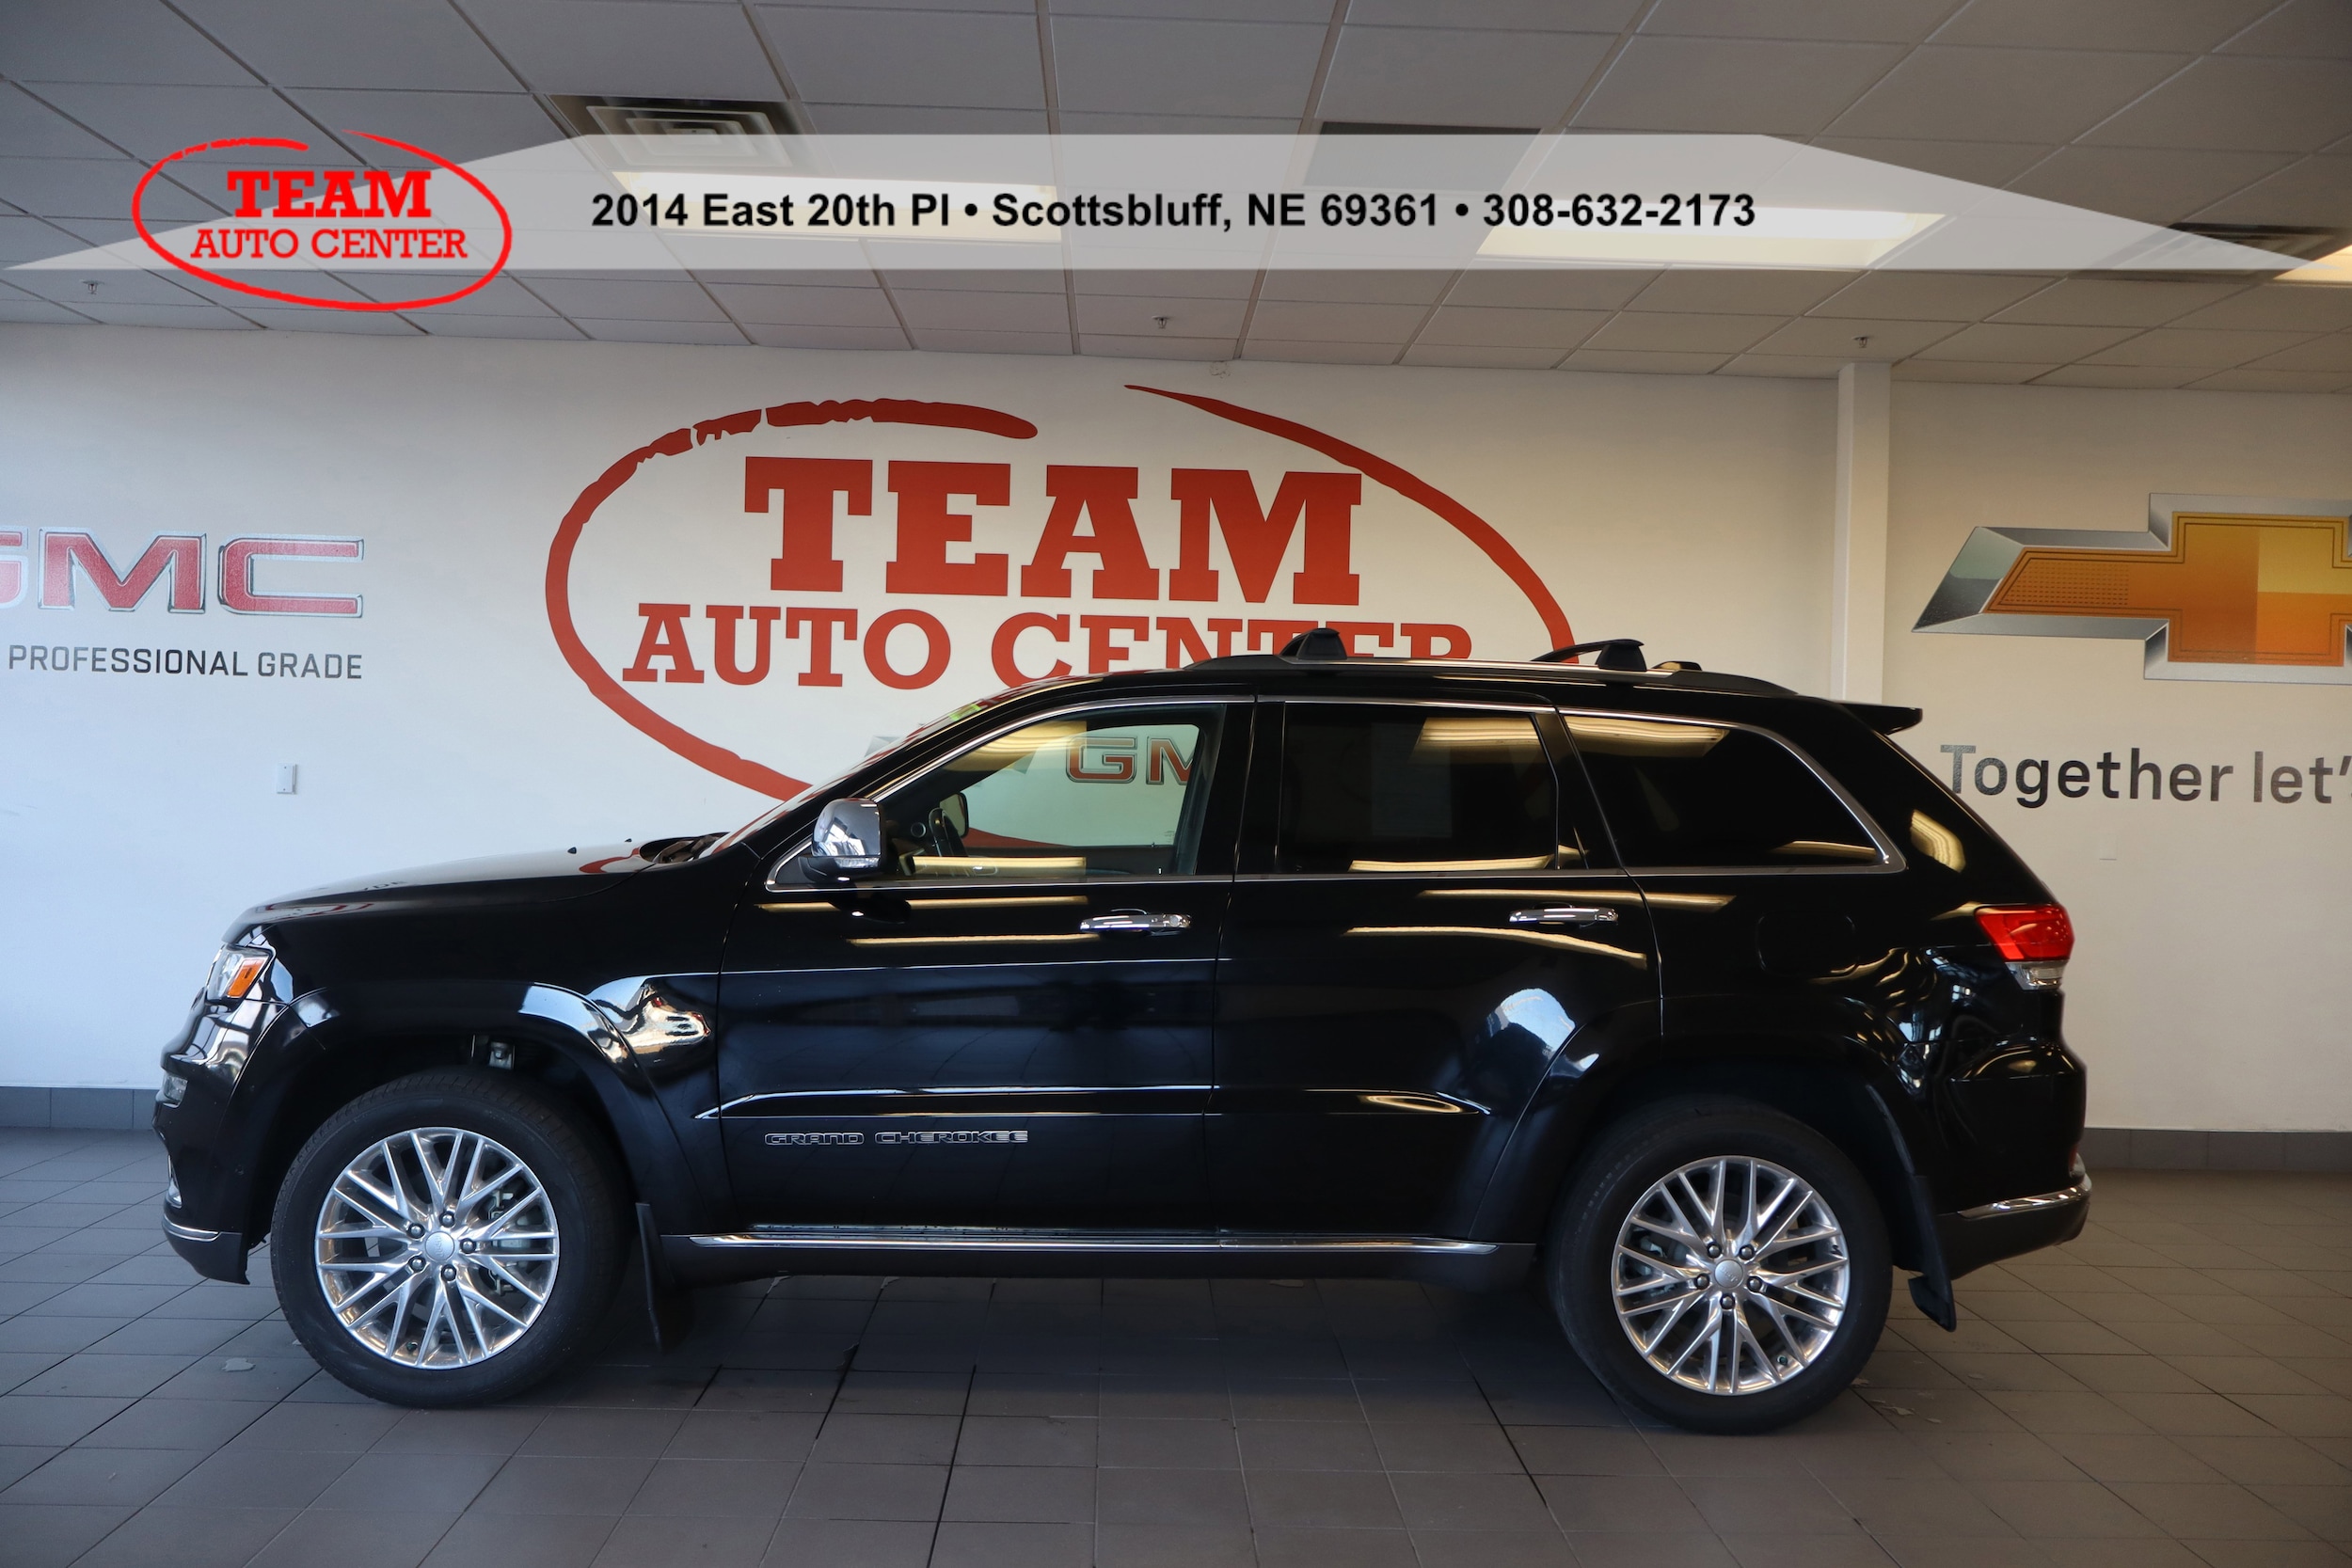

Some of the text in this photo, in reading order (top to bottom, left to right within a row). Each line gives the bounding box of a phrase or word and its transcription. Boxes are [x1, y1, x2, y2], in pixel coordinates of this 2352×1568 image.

[744, 456, 1361, 606] TEAM
[0, 526, 365, 618] MC
[8, 644, 362, 679] PROFESSIONAL GRADE
[622, 603, 951, 690] AUTO
[1941, 744, 2352, 809] Together let'
[764, 1130, 1028, 1146] GRAND CHEROKEE
